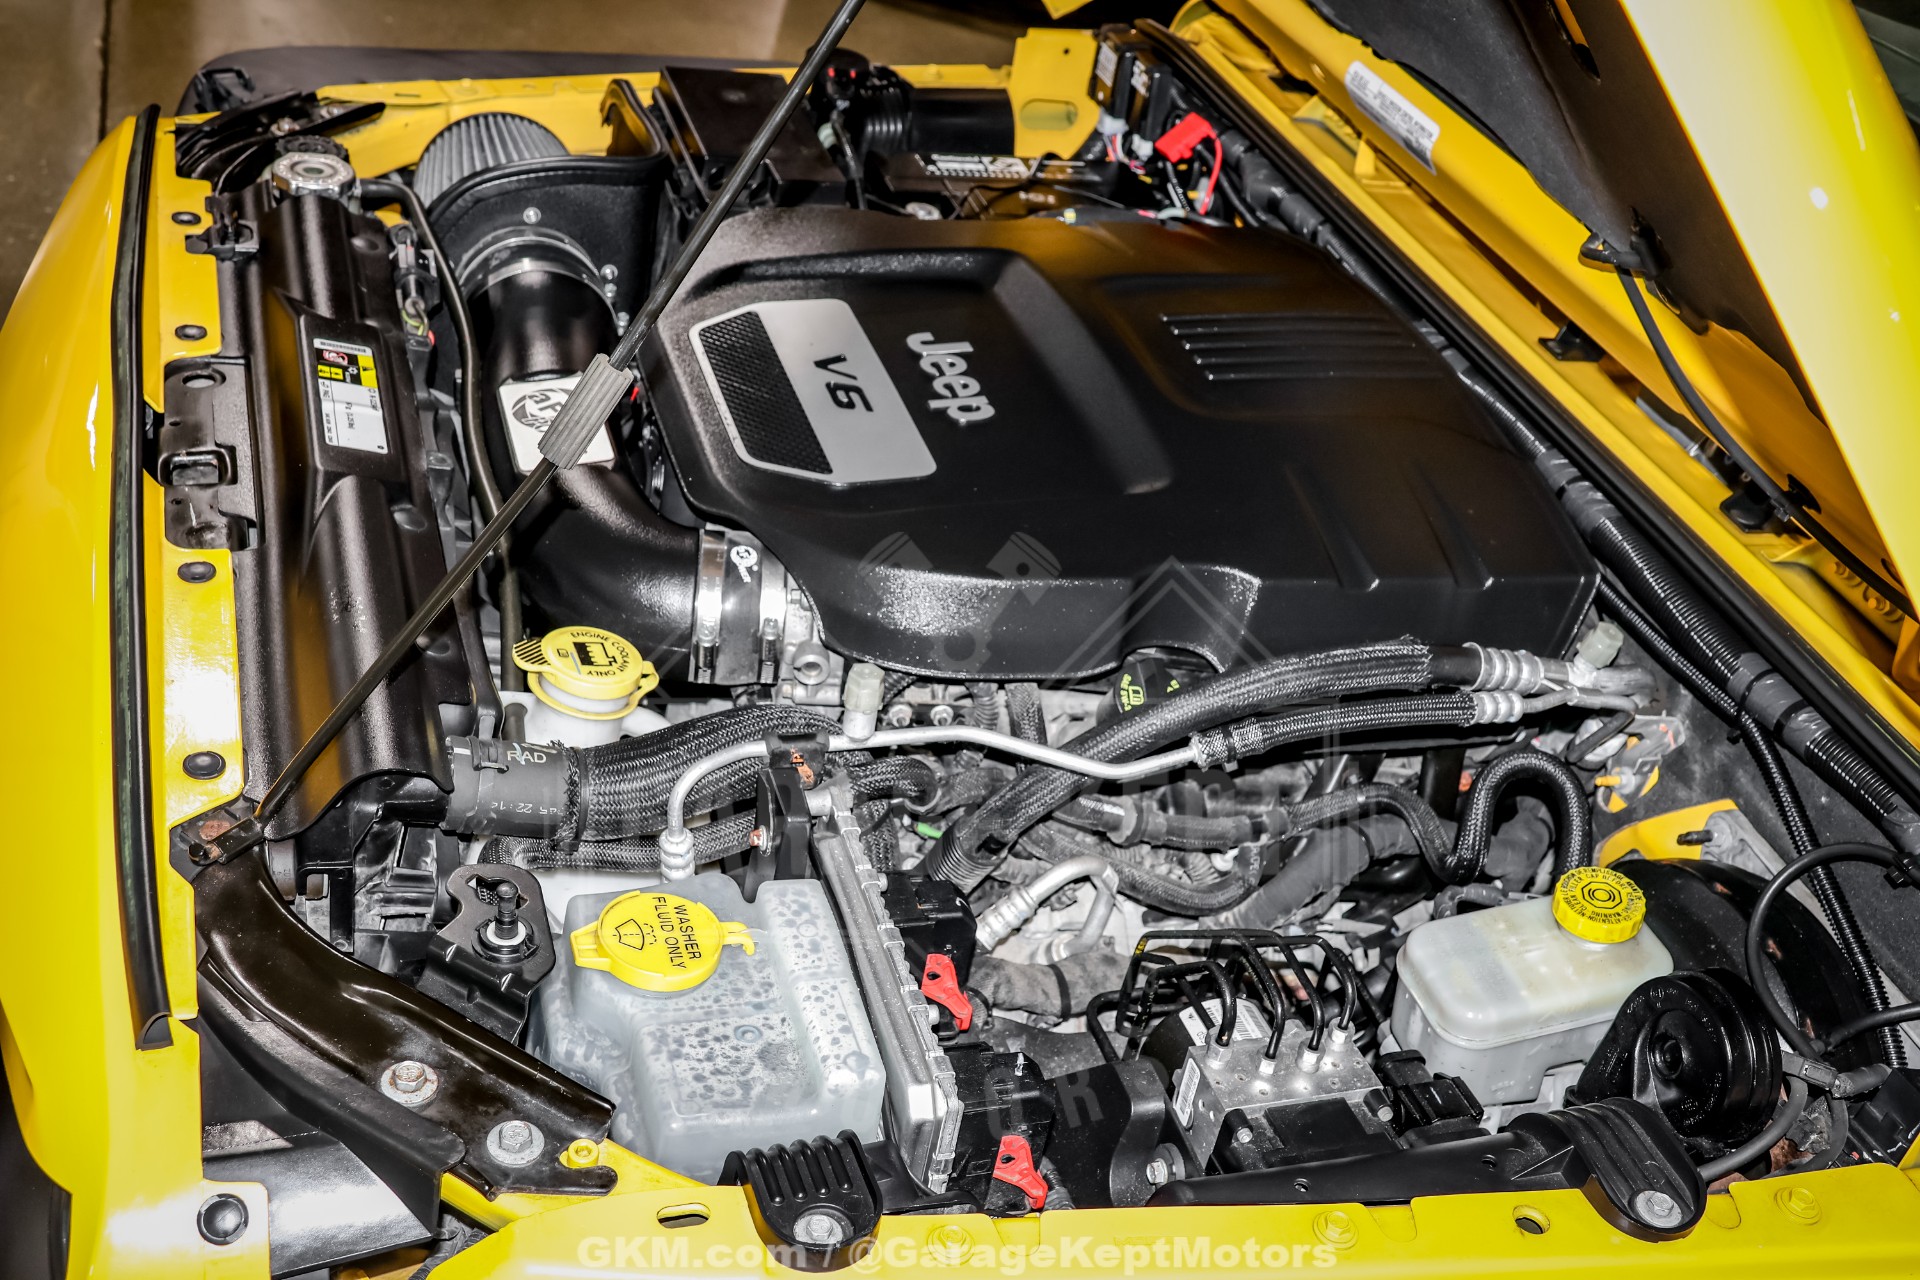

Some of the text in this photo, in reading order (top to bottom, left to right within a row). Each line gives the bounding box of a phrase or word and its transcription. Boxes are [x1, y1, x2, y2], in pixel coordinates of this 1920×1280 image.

[813, 354, 874, 412] V6
[906, 332, 996, 424] Jeep
[570, 632, 630, 672] ENGINE COOLANT
[587, 669, 616, 677] ONLY
[507, 750, 547, 764] RAD
[652, 896, 687, 969] FLUID ONLY
[673, 904, 702, 960] WASHER
